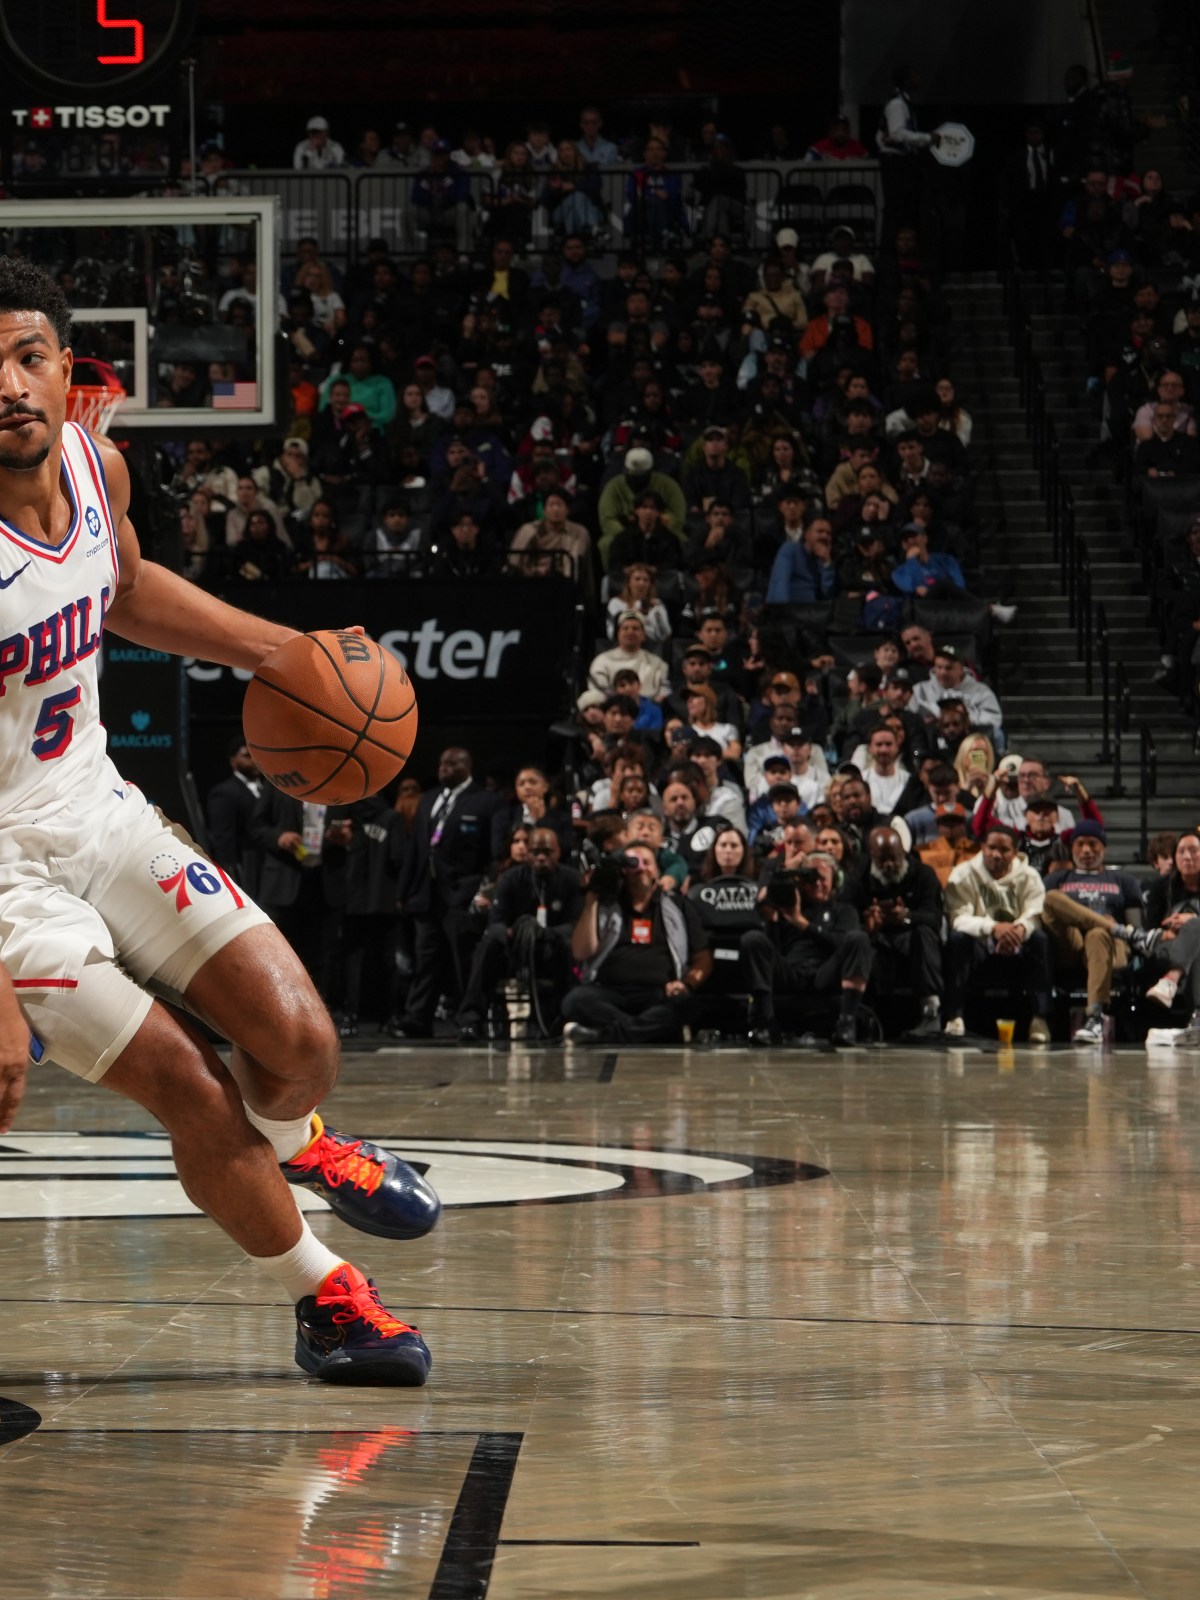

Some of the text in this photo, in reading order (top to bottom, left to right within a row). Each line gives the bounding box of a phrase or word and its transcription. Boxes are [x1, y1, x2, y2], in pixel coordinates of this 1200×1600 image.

[97, 0, 144, 64] 5
[54, 104, 171, 128] TISSOT
[86, 538, 109, 558] crypto.com
[108, 648, 172, 663] BARCLAYS
[31, 684, 81, 762] 5
[110, 734, 173, 748] BARCLAYS
[156, 861, 222, 914] 76
